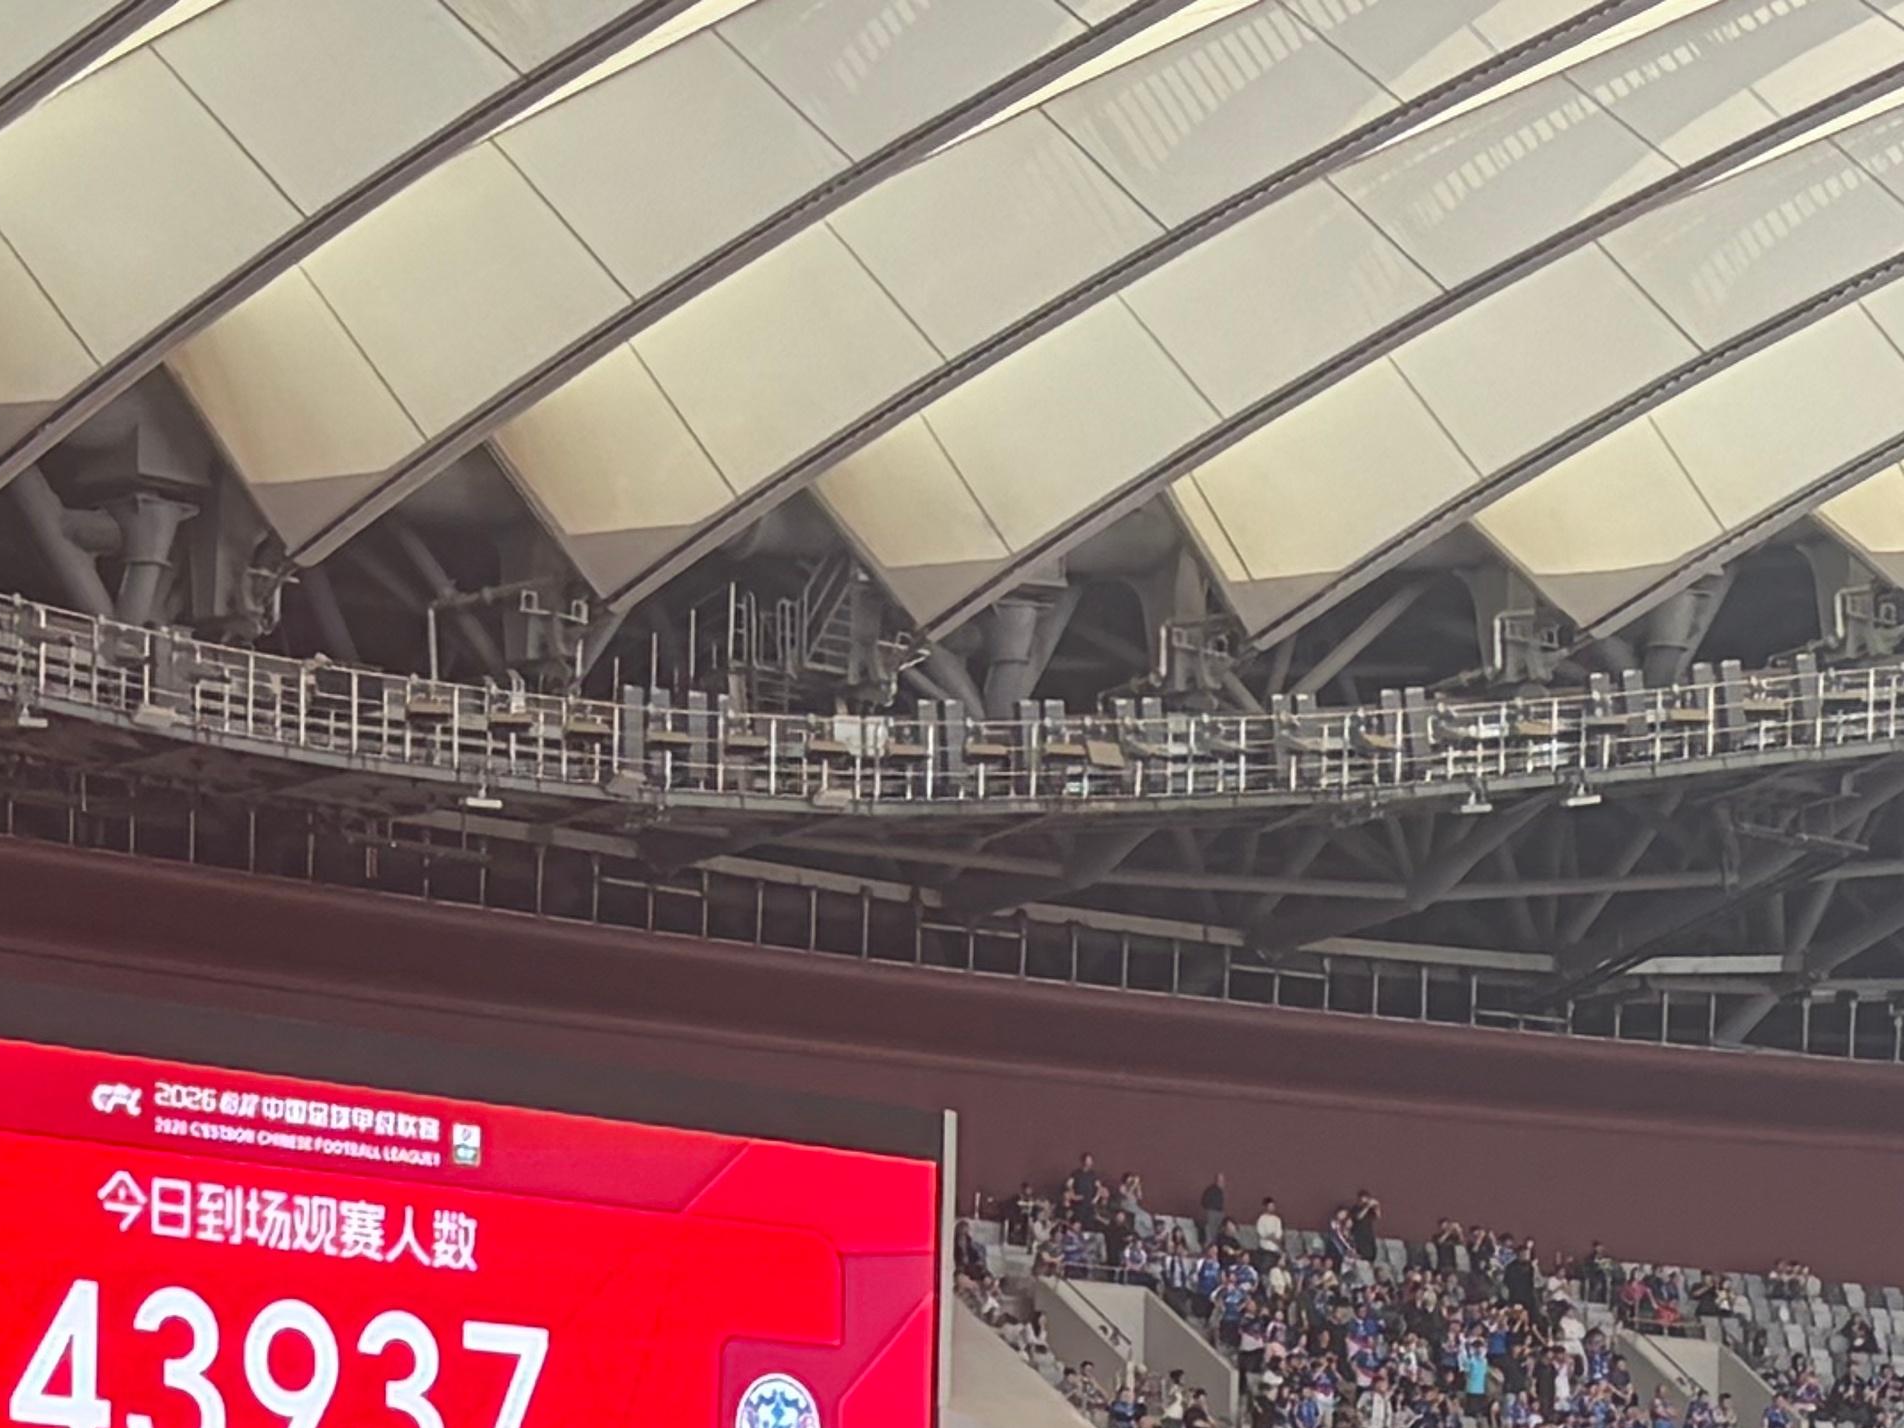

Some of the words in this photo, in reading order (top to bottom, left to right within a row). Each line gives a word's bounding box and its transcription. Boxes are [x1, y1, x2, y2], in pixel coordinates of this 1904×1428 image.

[97, 1170, 477, 1271] 今日到场观赛人数
